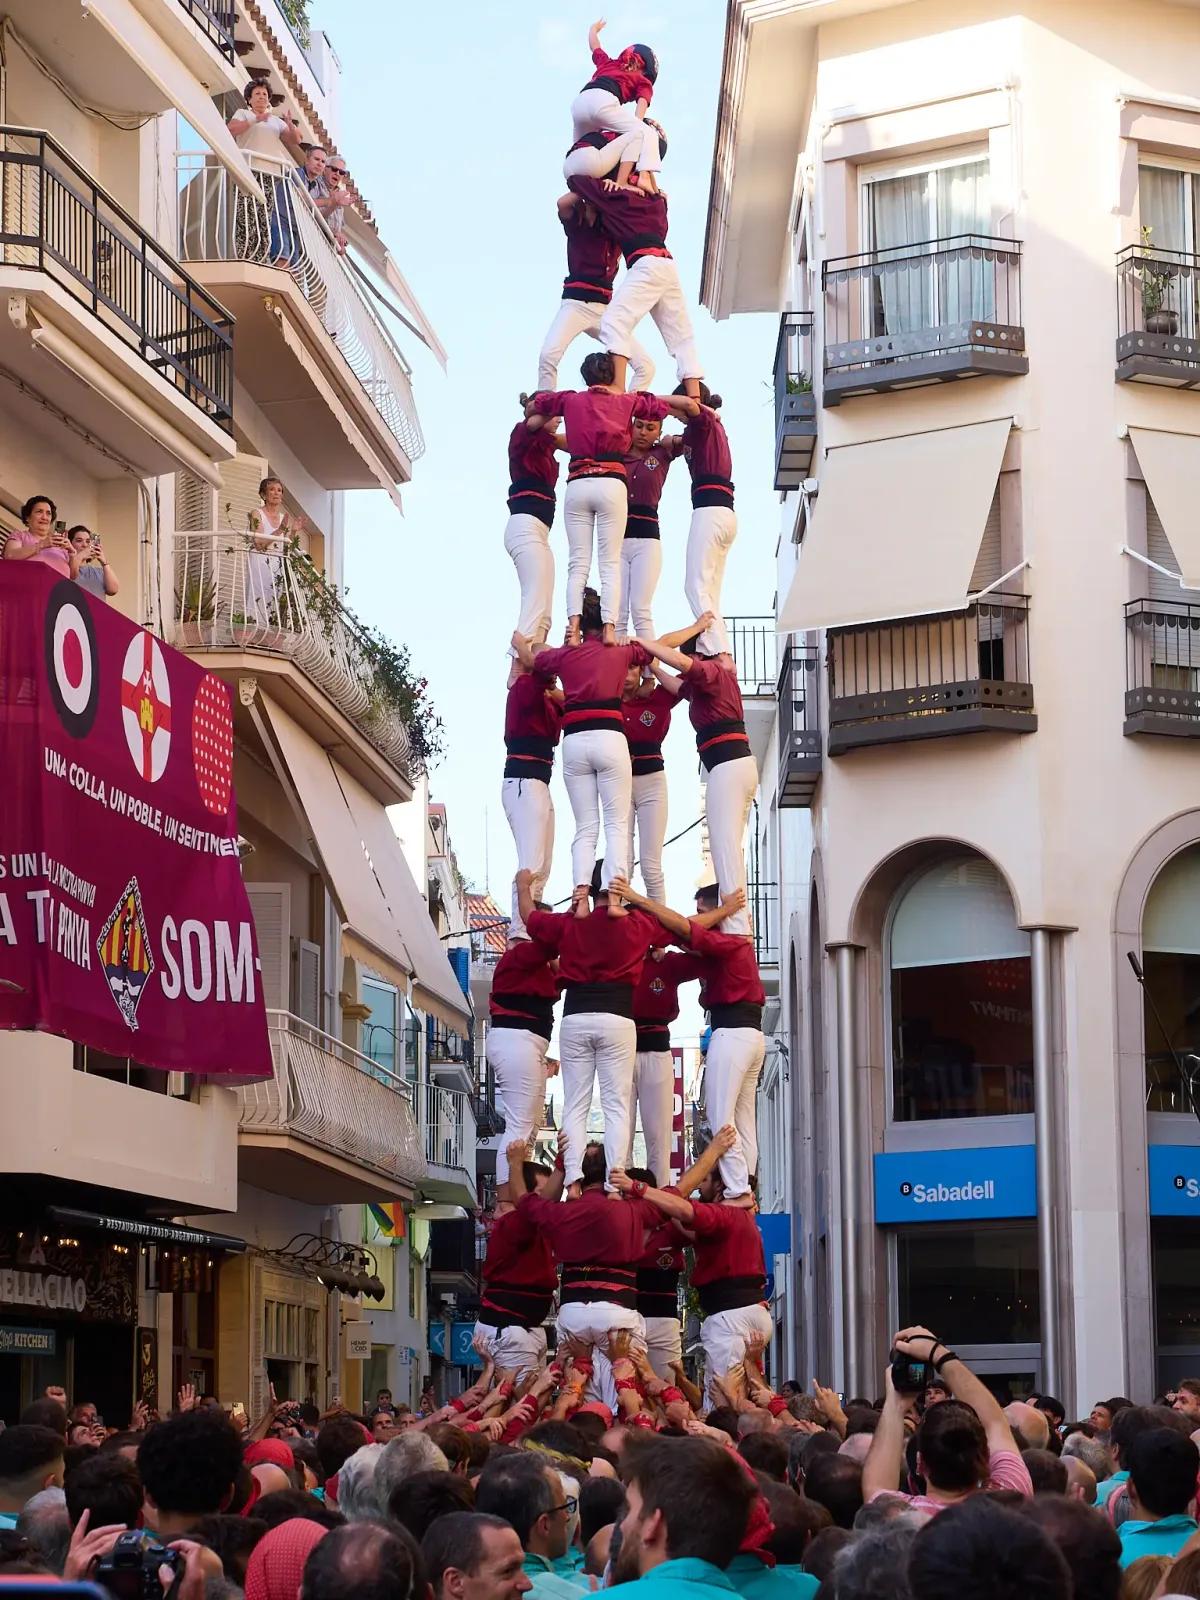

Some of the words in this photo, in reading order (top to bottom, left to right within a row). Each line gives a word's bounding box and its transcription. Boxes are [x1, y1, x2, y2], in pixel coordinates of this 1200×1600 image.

[45, 747, 67, 778] UNA
[69, 762, 107, 808] COLLA,
[110, 786, 127, 815] UN
[127, 795, 162, 836] POBLE,
[164, 815, 179, 840] UN
[11, 853, 38, 877] UN
[57, 901, 91, 971] PINYA
[913, 1180, 994, 1203] Sabadell
[1187, 1178, 1200, 1198] S
[106, 1218, 150, 1236] RESTAURANTE
[14, 1332, 48, 1349] KITCHEN
